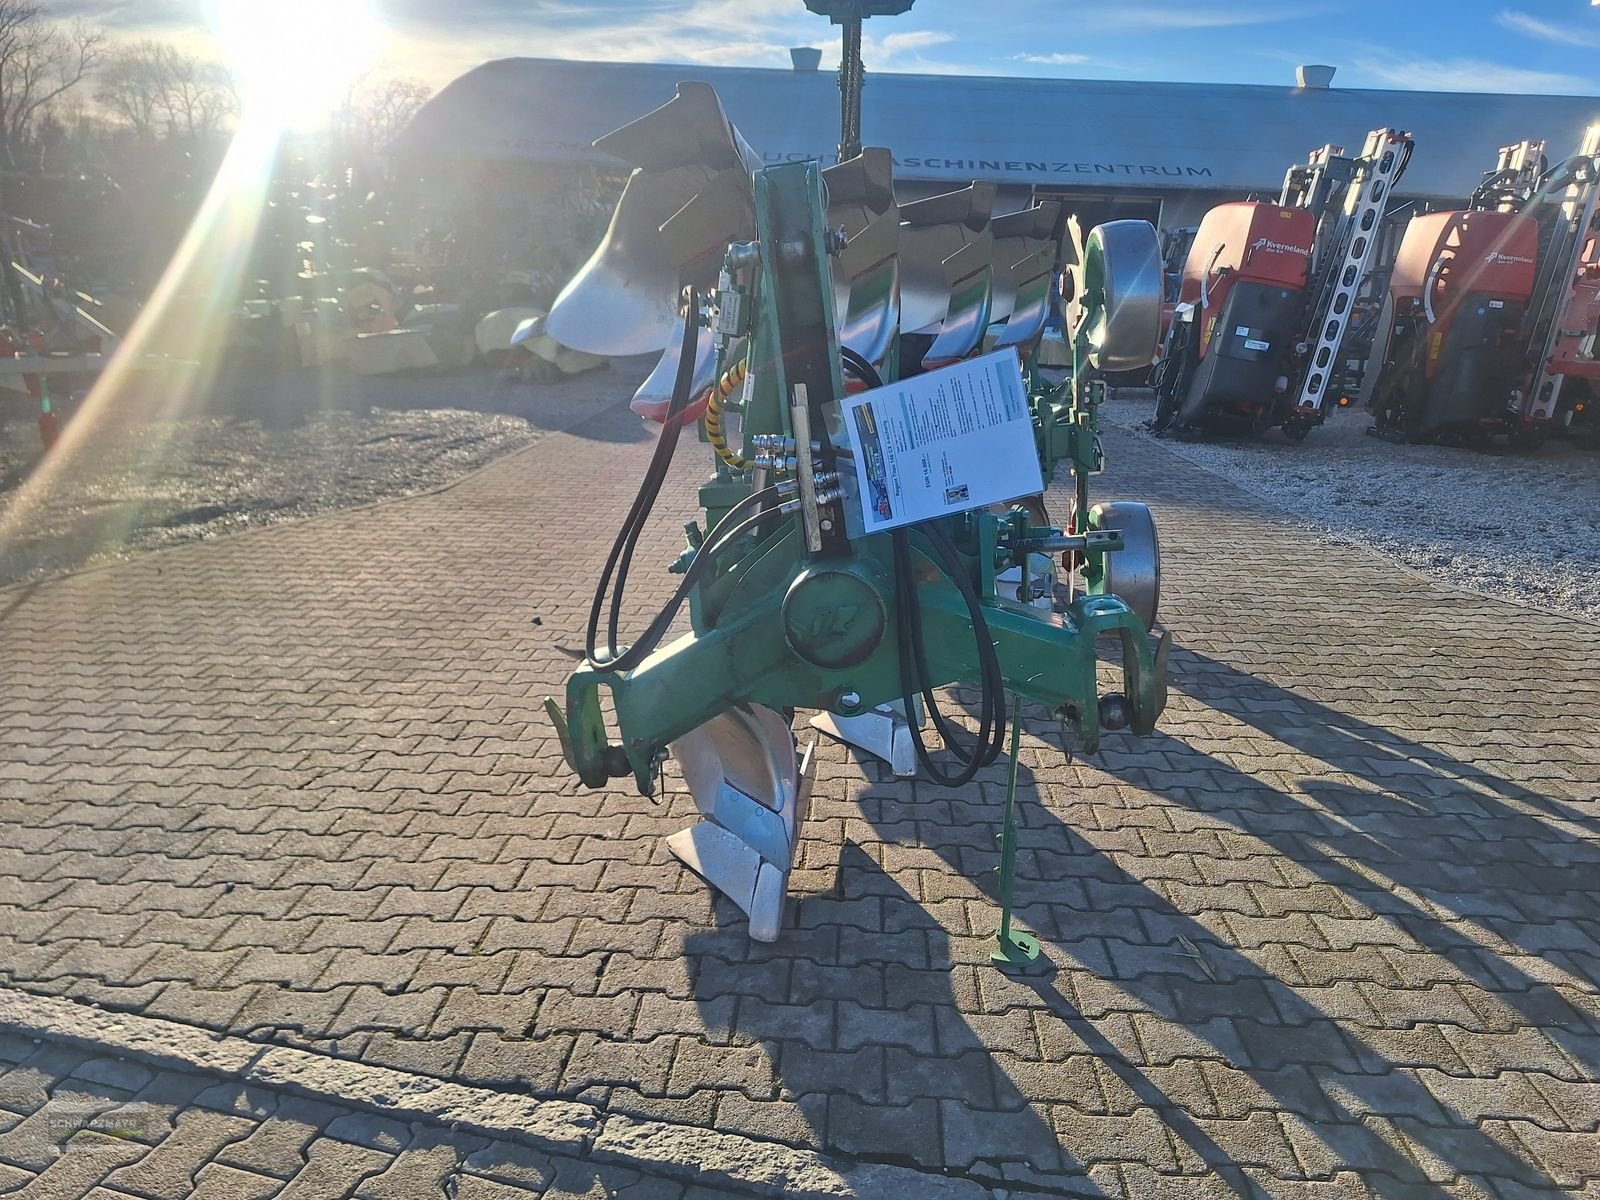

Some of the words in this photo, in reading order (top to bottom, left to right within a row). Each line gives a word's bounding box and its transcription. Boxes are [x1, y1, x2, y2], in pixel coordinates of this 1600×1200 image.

[1266, 240, 1310, 256] Kverneland
[1498, 253, 1534, 264] Kverneland
[923, 475, 931, 488] EUR
